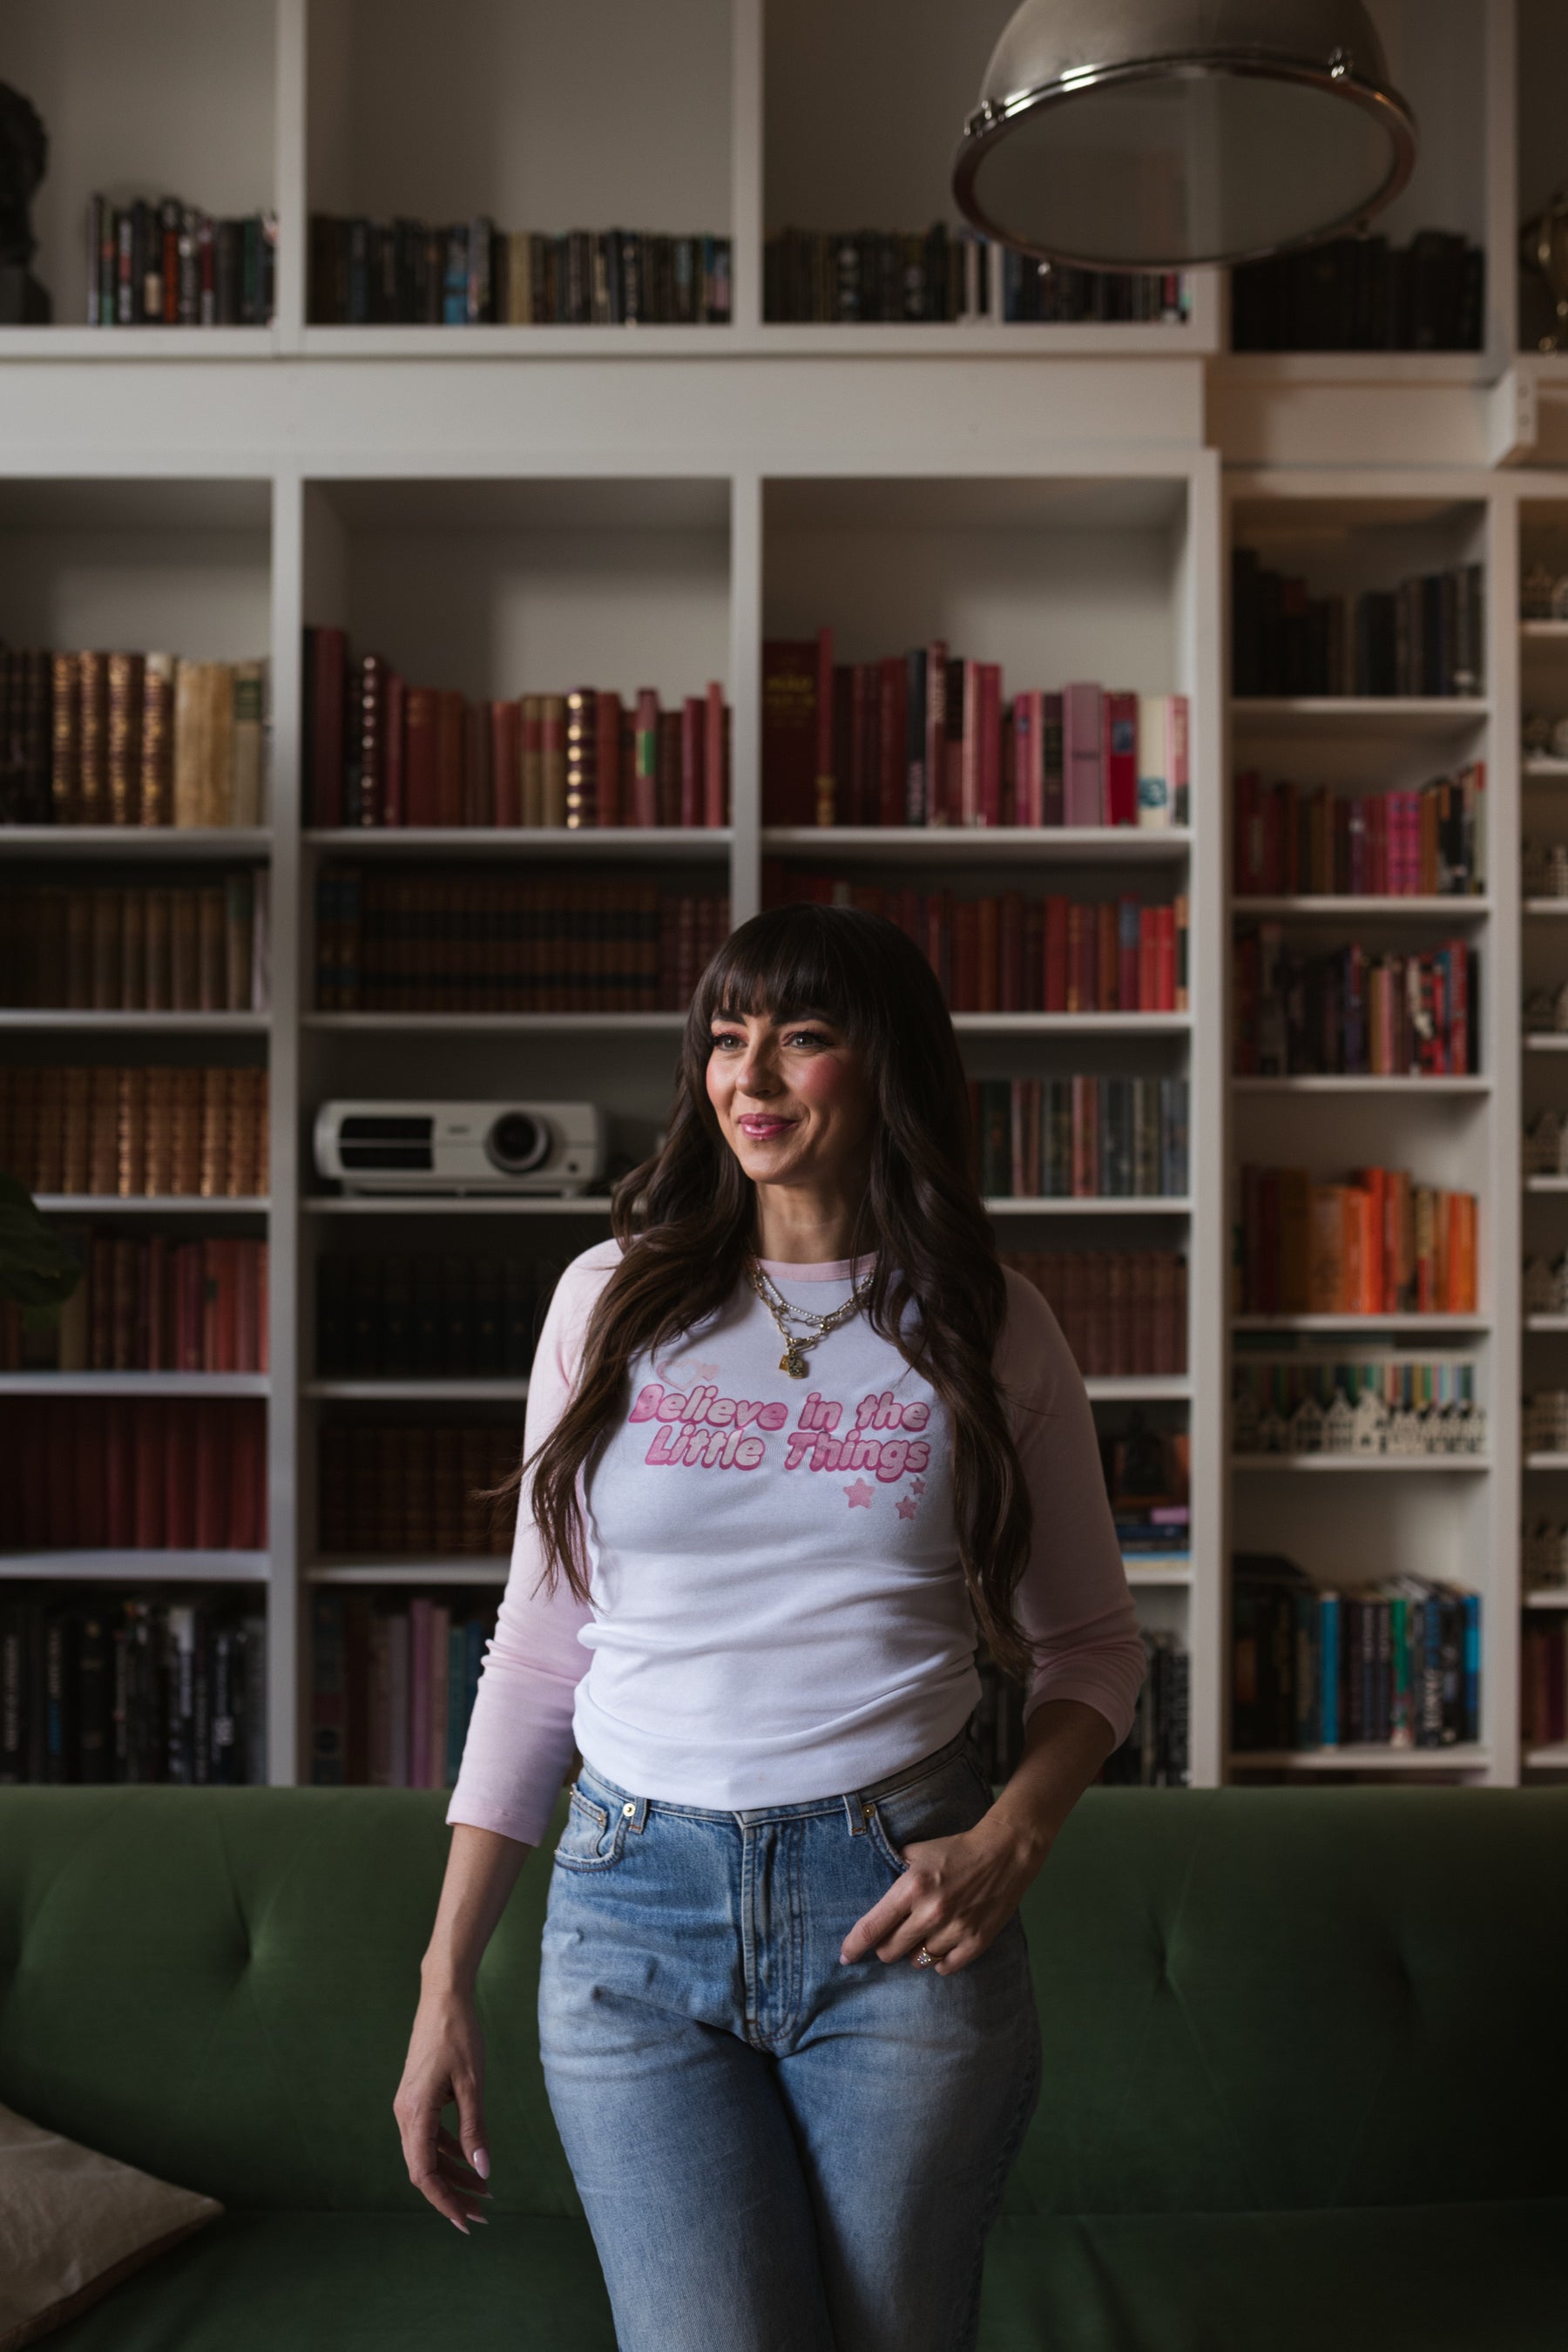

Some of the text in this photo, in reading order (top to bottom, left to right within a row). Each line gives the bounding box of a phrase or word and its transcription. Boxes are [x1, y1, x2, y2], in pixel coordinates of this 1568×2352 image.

[629, 1384, 930, 1432] Believe in the
[645, 1423, 930, 1483] Little Things
